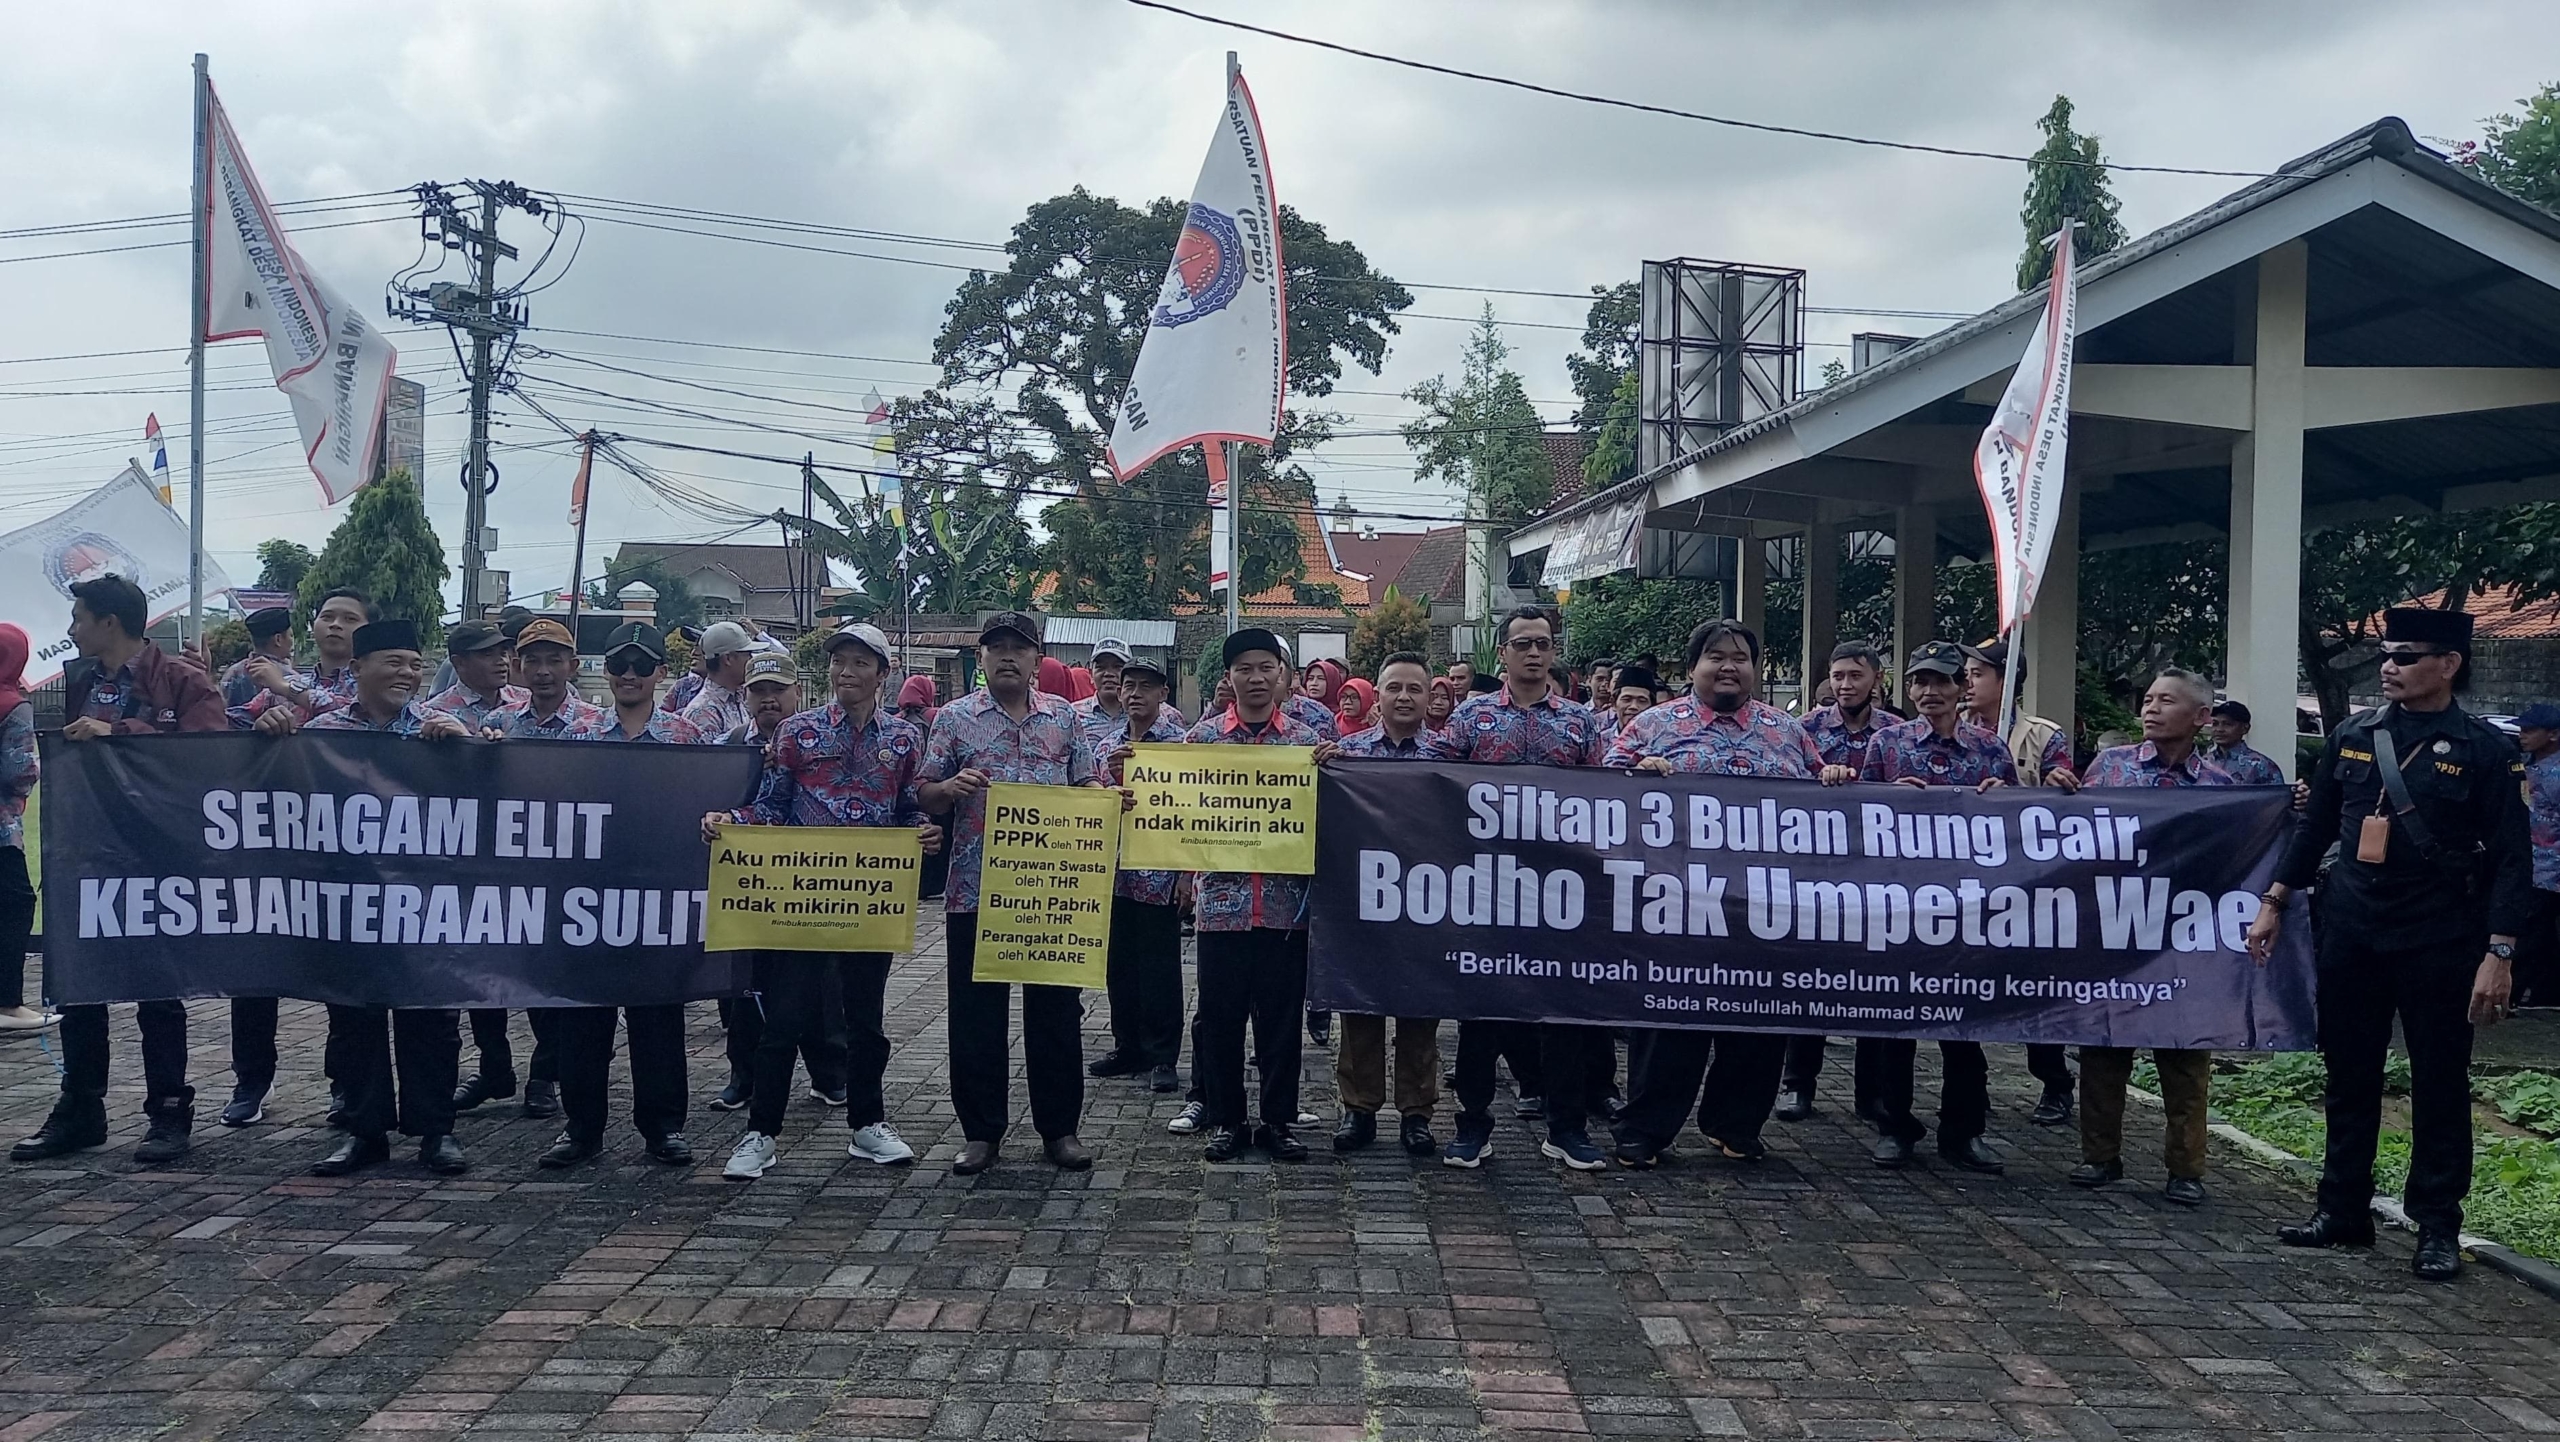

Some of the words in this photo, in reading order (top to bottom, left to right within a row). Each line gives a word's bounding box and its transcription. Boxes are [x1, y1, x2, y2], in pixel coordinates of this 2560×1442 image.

[1251, 172, 1275, 281] PERANGKAT
[1235, 207, 1266, 284] (PPDI)
[1269, 285, 1278, 331] DESA
[1269, 337, 1279, 433] INDONESIA
[1131, 766, 1171, 783] Aku
[1179, 768, 1248, 786] mikirin
[1256, 770, 1311, 787] kamu
[1150, 791, 1191, 807] eh...
[1199, 792, 1291, 813] kamunya
[202, 788, 479, 857] SERAGAM
[494, 801, 612, 861] ELIT
[996, 806, 1040, 825] PNS
[1043, 814, 1070, 828] oleh
[1075, 817, 1103, 829] THR
[1135, 814, 1184, 831] ndak
[1191, 815, 1261, 833] mikirin
[1268, 817, 1304, 834] aku
[1467, 782, 1628, 851] Siltap
[1640, 791, 1675, 849] 3
[1688, 794, 1848, 856] Bulan
[1861, 802, 2009, 867] Rung
[2018, 805, 2149, 868] Cair,
[993, 830, 1049, 849] PPPK
[1051, 838, 1071, 849] oleh
[1076, 840, 1103, 851] THR
[719, 849, 763, 866] Aku
[771, 851, 848, 867] mikirin
[856, 853, 914, 869] kamu
[989, 856, 1055, 872] Karyawan
[1059, 860, 1106, 873] Swasta
[738, 874, 784, 891] eh...
[793, 875, 893, 895] kamunya
[1015, 874, 1044, 888] oleh
[1049, 876, 1079, 888] THR
[78, 876, 547, 945] KESEJAHTERAAN
[722, 897, 776, 913] ndak
[784, 898, 859, 915] mikirin
[867, 900, 905, 915] aku
[990, 894, 1042, 910] Buruh
[1048, 896, 1101, 913] Pabrik
[1359, 849, 1585, 931] Bodho
[1602, 859, 1730, 938] Tak
[1746, 866, 2078, 952] Umpetan
[2095, 876, 2260, 953] Wae
[1015, 913, 1040, 924] oleh
[1046, 914, 1073, 925] THR
[982, 930, 1063, 947] Perangakat
[1068, 933, 1103, 947] Desa
[998, 949, 1023, 961] oleh
[1028, 950, 1086, 964] KABARE
[1571, 958, 1638, 985] upah
[1648, 960, 1772, 989] buruhmu
[1782, 966, 1900, 994] sebelum
[1909, 971, 1996, 1001] kering
[1644, 993, 1700, 1012] Sabda
[1706, 995, 1803, 1017] Rosulullah
[1808, 999, 1915, 1021] Muhammad
[1920, 1005, 1964, 1022] SAW
